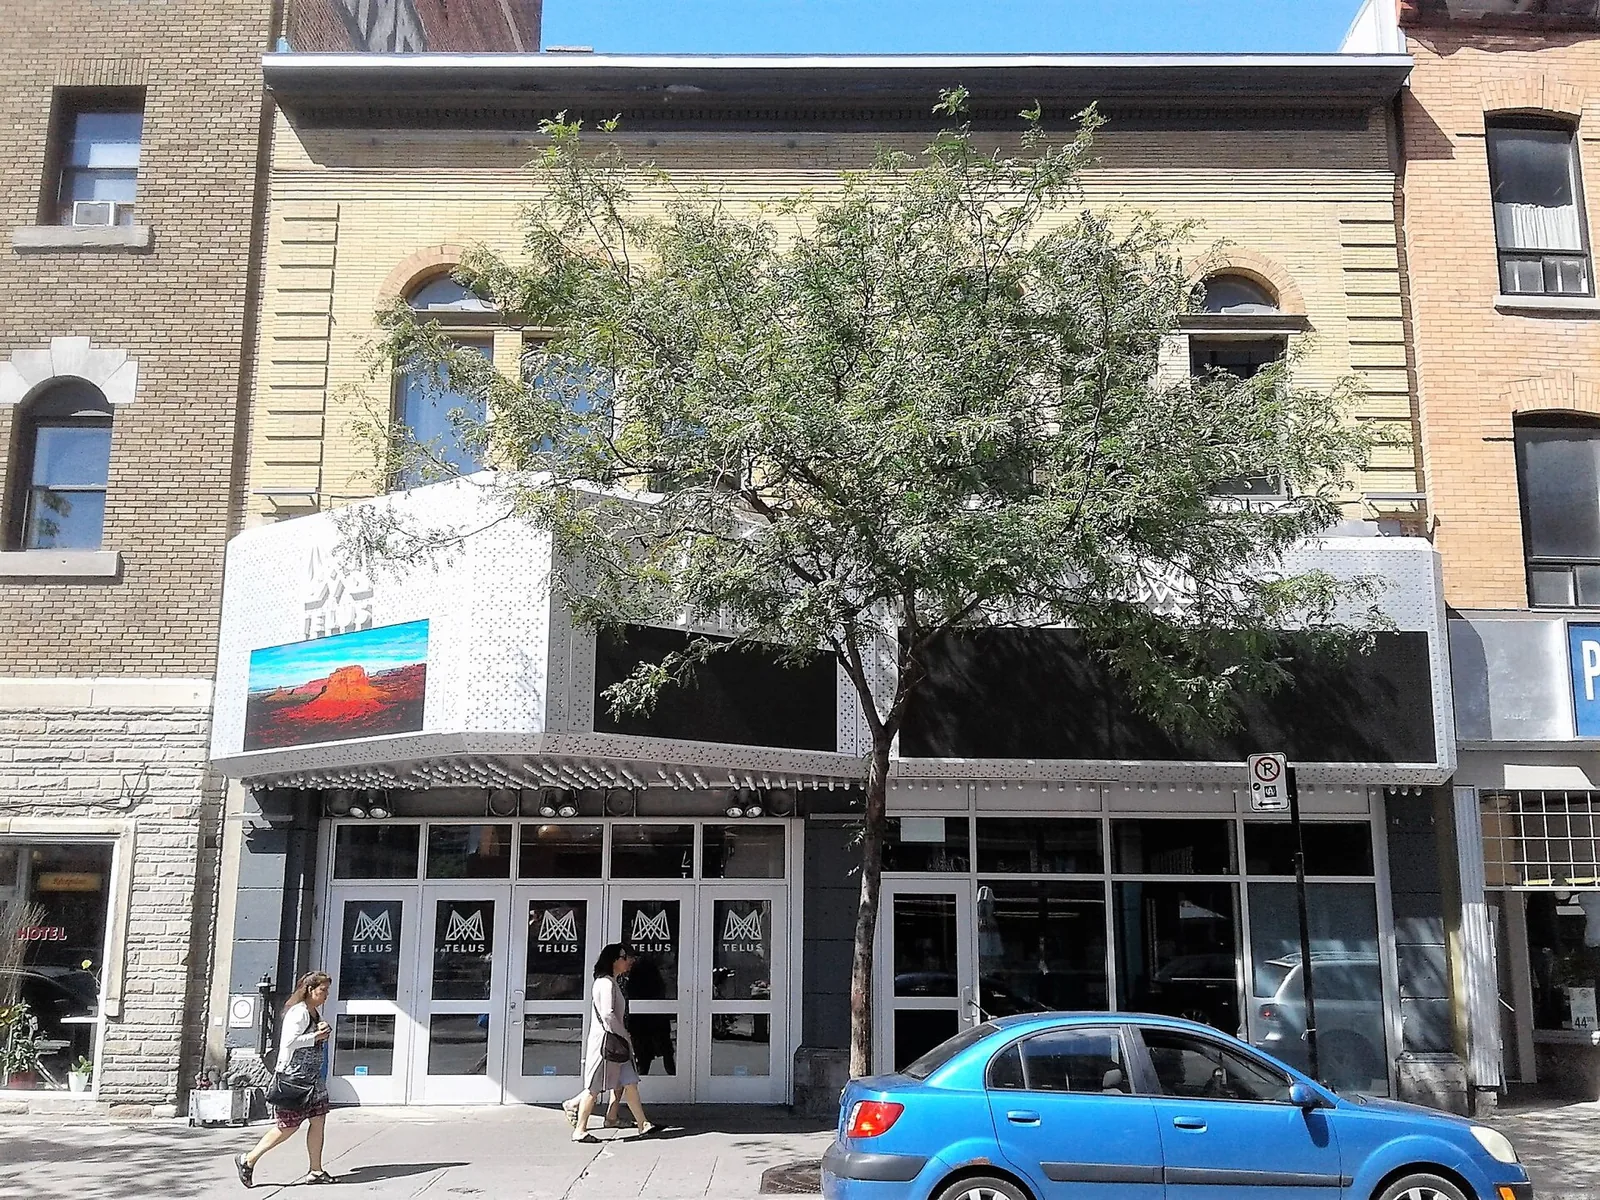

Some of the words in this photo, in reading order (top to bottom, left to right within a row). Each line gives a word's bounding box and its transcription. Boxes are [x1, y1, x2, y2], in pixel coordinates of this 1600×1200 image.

[1581, 640, 1600, 701] P
[17, 926, 68, 941] HOTEL
[352, 944, 393, 953] TELUS
[445, 944, 485, 953] TELUS
[538, 944, 578, 953] TELUS
[631, 944, 671, 953] TELUS
[723, 944, 763, 953] TELUS
